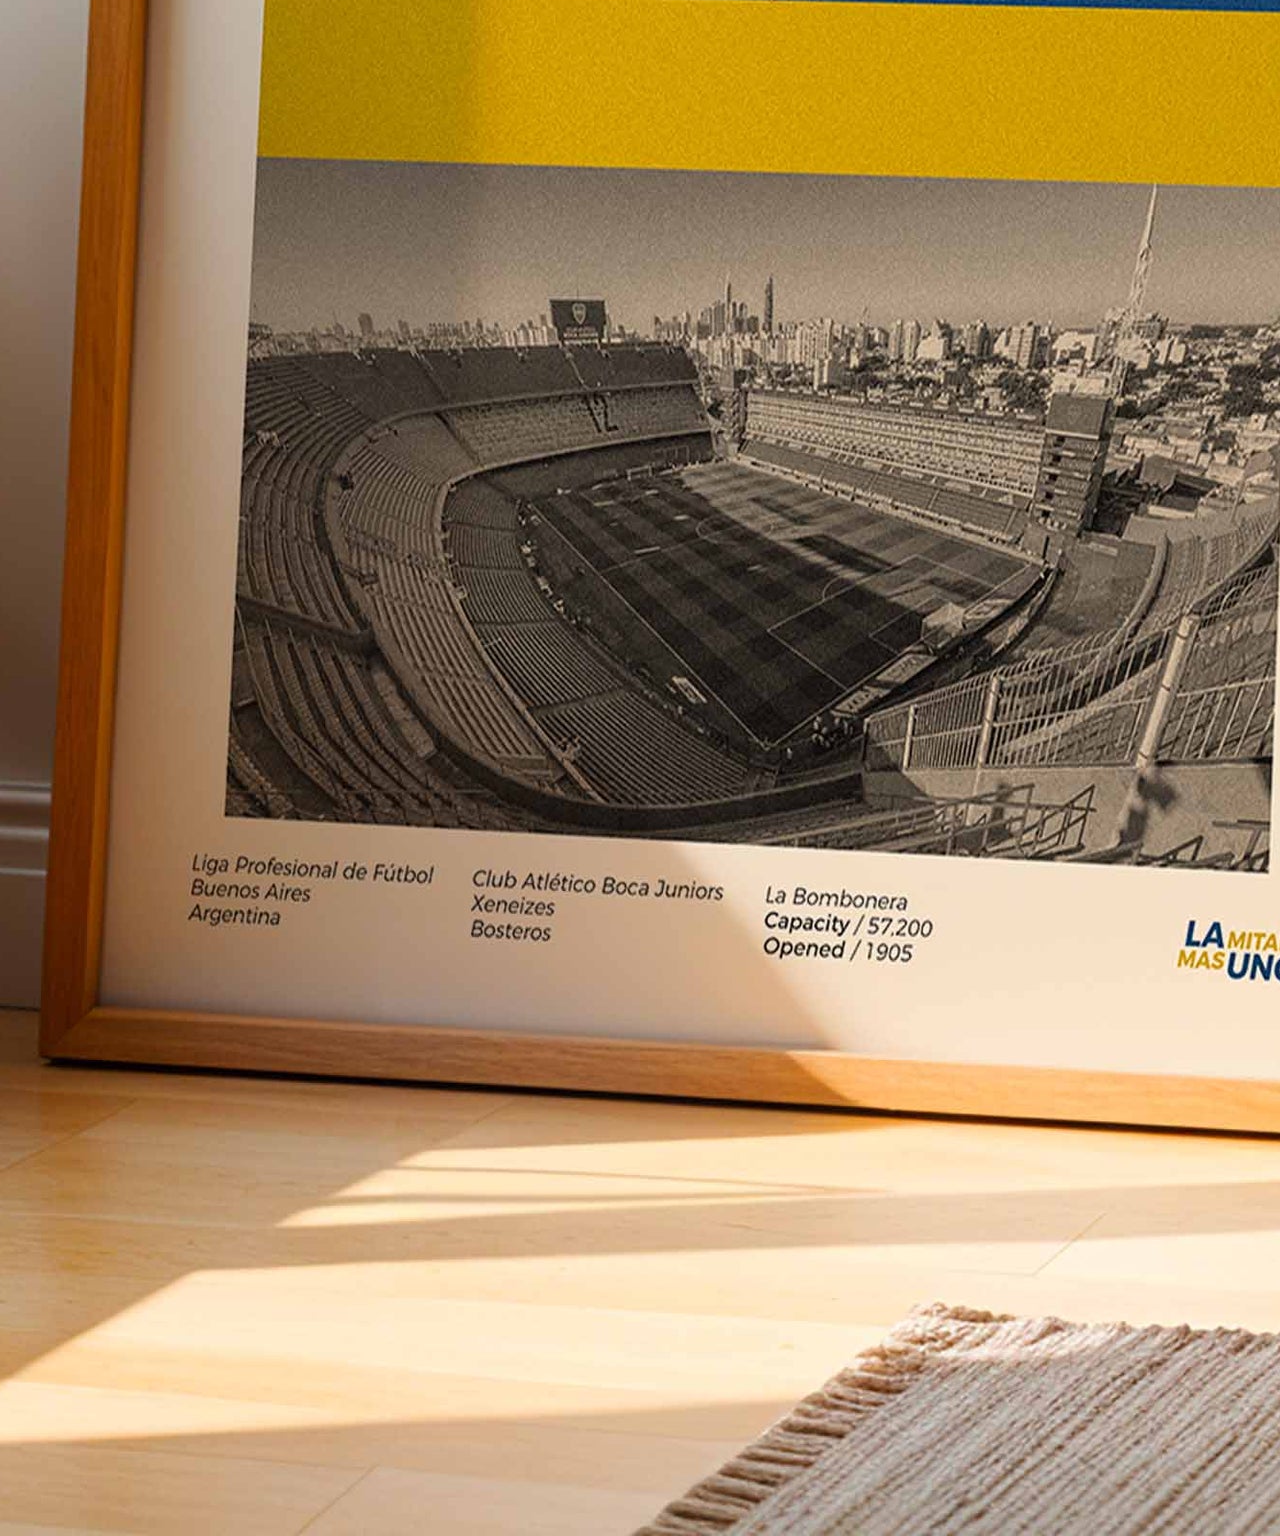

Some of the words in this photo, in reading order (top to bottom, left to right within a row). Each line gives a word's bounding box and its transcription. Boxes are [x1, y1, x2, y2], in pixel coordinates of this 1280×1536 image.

[192, 854, 229, 877] Liga
[235, 856, 339, 879] Profesional
[342, 862, 368, 881] de
[373, 863, 434, 884] Fútbol
[191, 878, 260, 899] Buenos
[264, 883, 311, 903] Aires
[472, 869, 518, 889] Club
[521, 872, 596, 894] Atlético
[601, 876, 650, 897] Boca
[654, 879, 724, 901] Juniors
[471, 894, 555, 917] Xeneizes
[765, 886, 787, 905] La
[792, 887, 908, 912] Bombonera
[188, 904, 281, 927] Argentina
[764, 911, 851, 938] Capacity
[852, 914, 866, 937] /
[471, 919, 551, 942] Bosteros
[1185, 920, 1224, 949] LA
[763, 936, 847, 960] Opened
[849, 939, 862, 962] /
[867, 941, 914, 963] 1905
[1177, 950, 1225, 970] MAS
